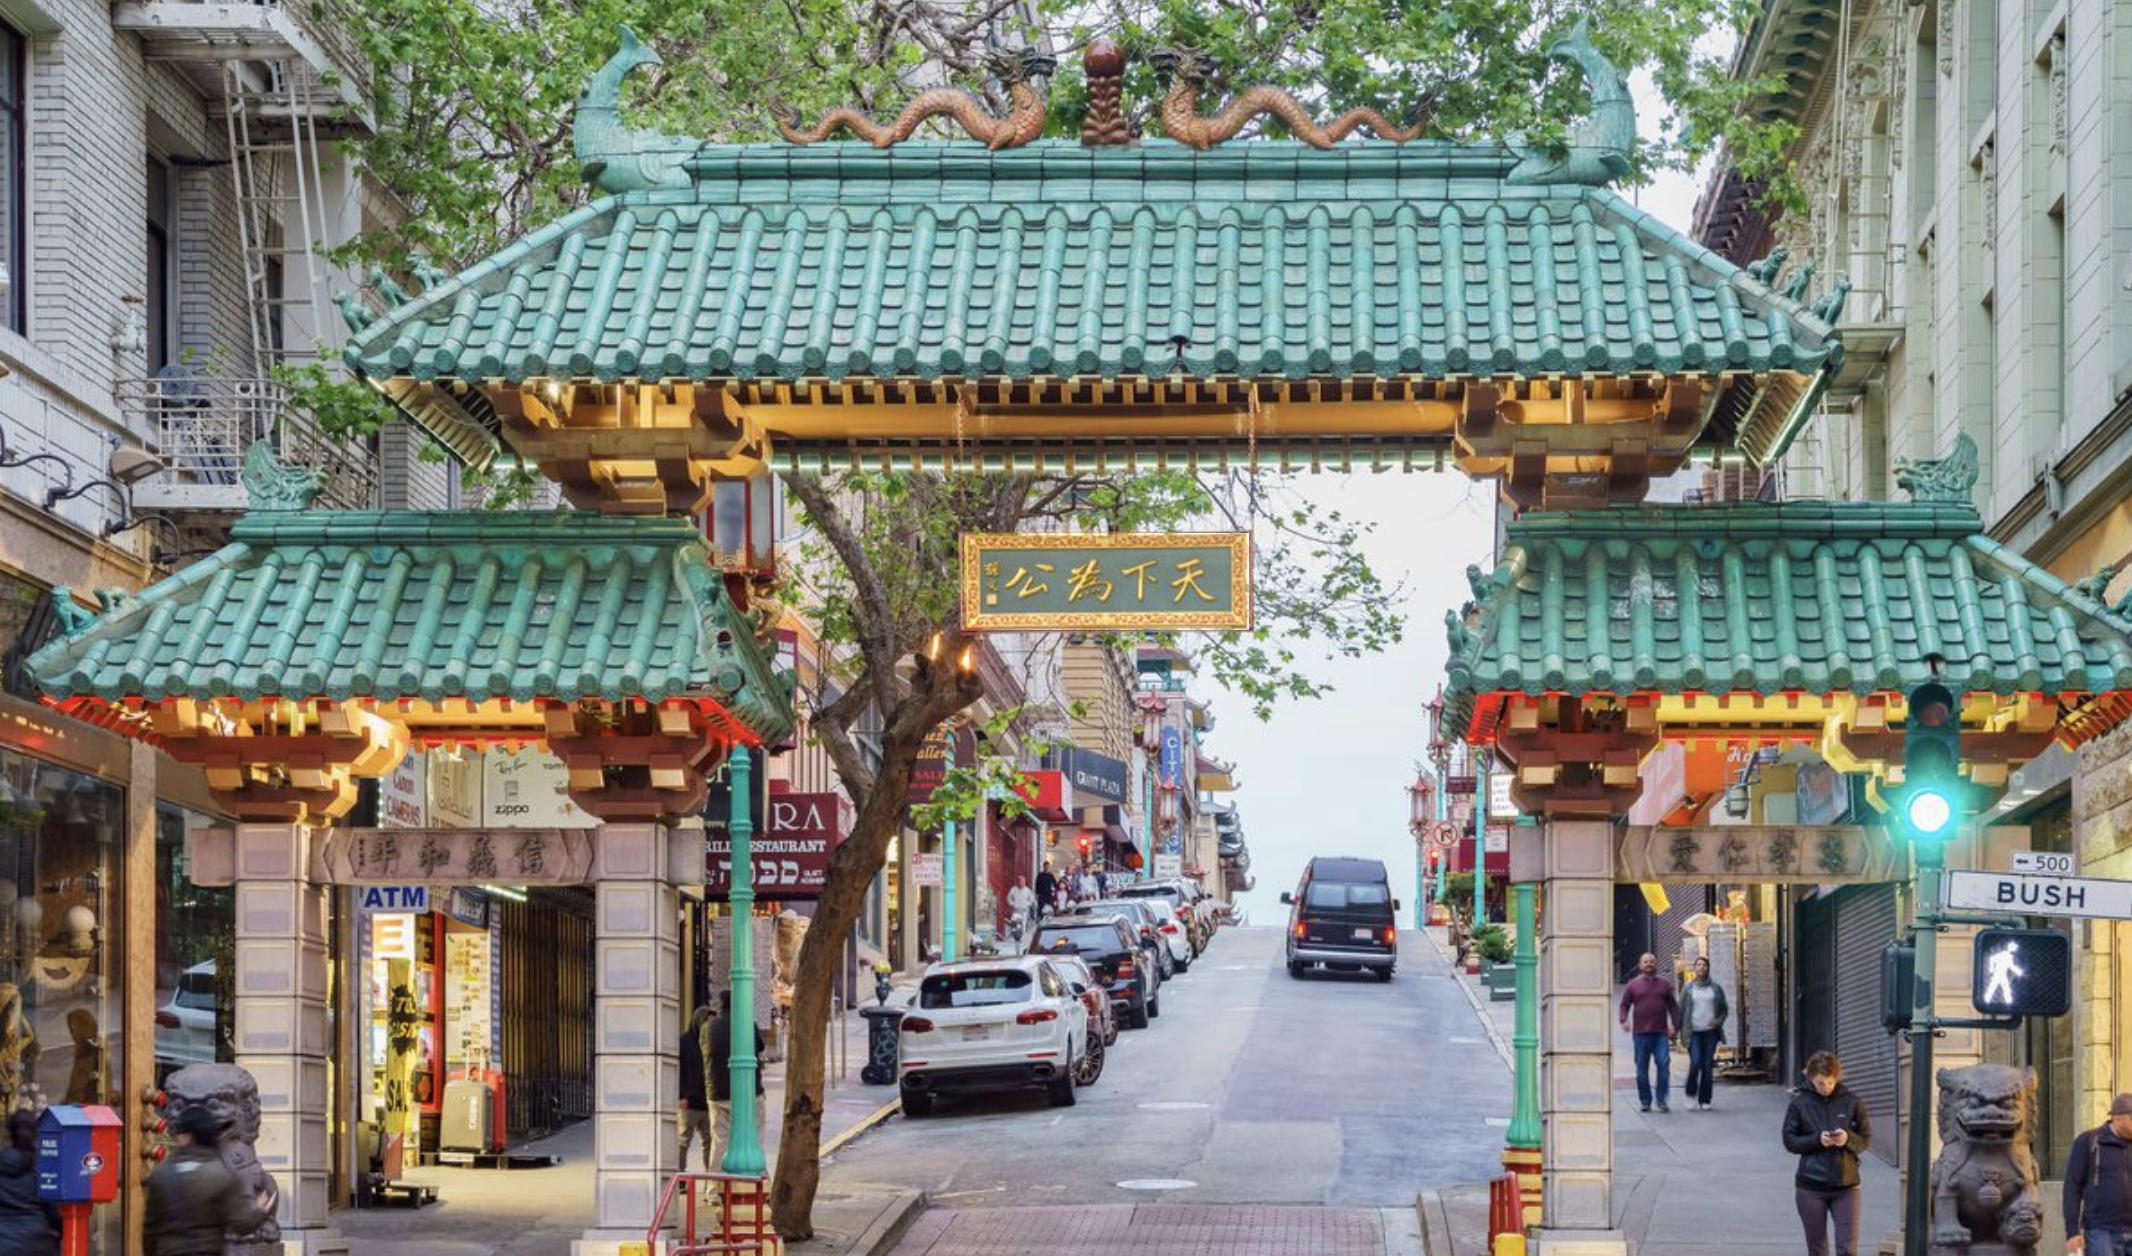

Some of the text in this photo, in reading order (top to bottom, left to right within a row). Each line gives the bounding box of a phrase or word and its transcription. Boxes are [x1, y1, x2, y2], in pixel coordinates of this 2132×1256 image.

[1005, 558, 1215, 603] 天下為公
[1077, 770, 1120, 795] GRANT PLAZA
[495, 804, 529, 815] zippo
[749, 839, 826, 853] ESTAURANT
[2036, 856, 2070, 871] 500
[364, 886, 424, 908] ATM
[1997, 881, 2085, 908] BUSH
